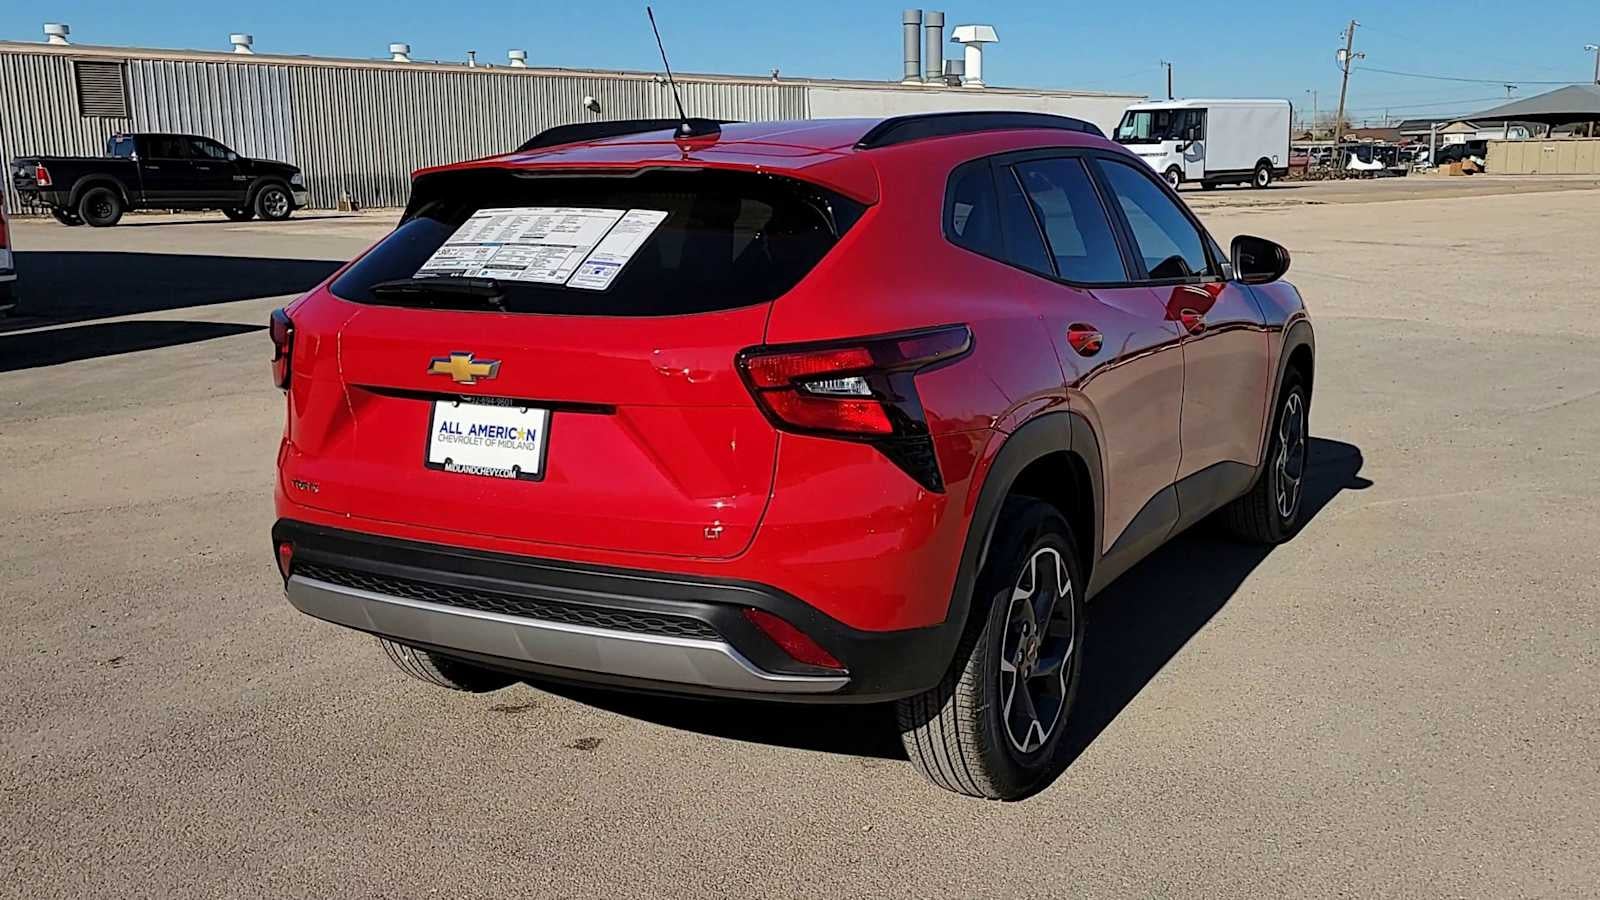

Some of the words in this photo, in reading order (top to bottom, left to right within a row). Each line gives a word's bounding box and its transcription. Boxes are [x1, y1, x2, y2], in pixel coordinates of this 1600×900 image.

[439, 420, 463, 435] ALL
[437, 433, 484, 446] CHEVROLET
[484, 438, 497, 447] OF
[497, 440, 535, 451] MIDLAND
[444, 463, 517, 479] MIDLANDCHEVY.COM
